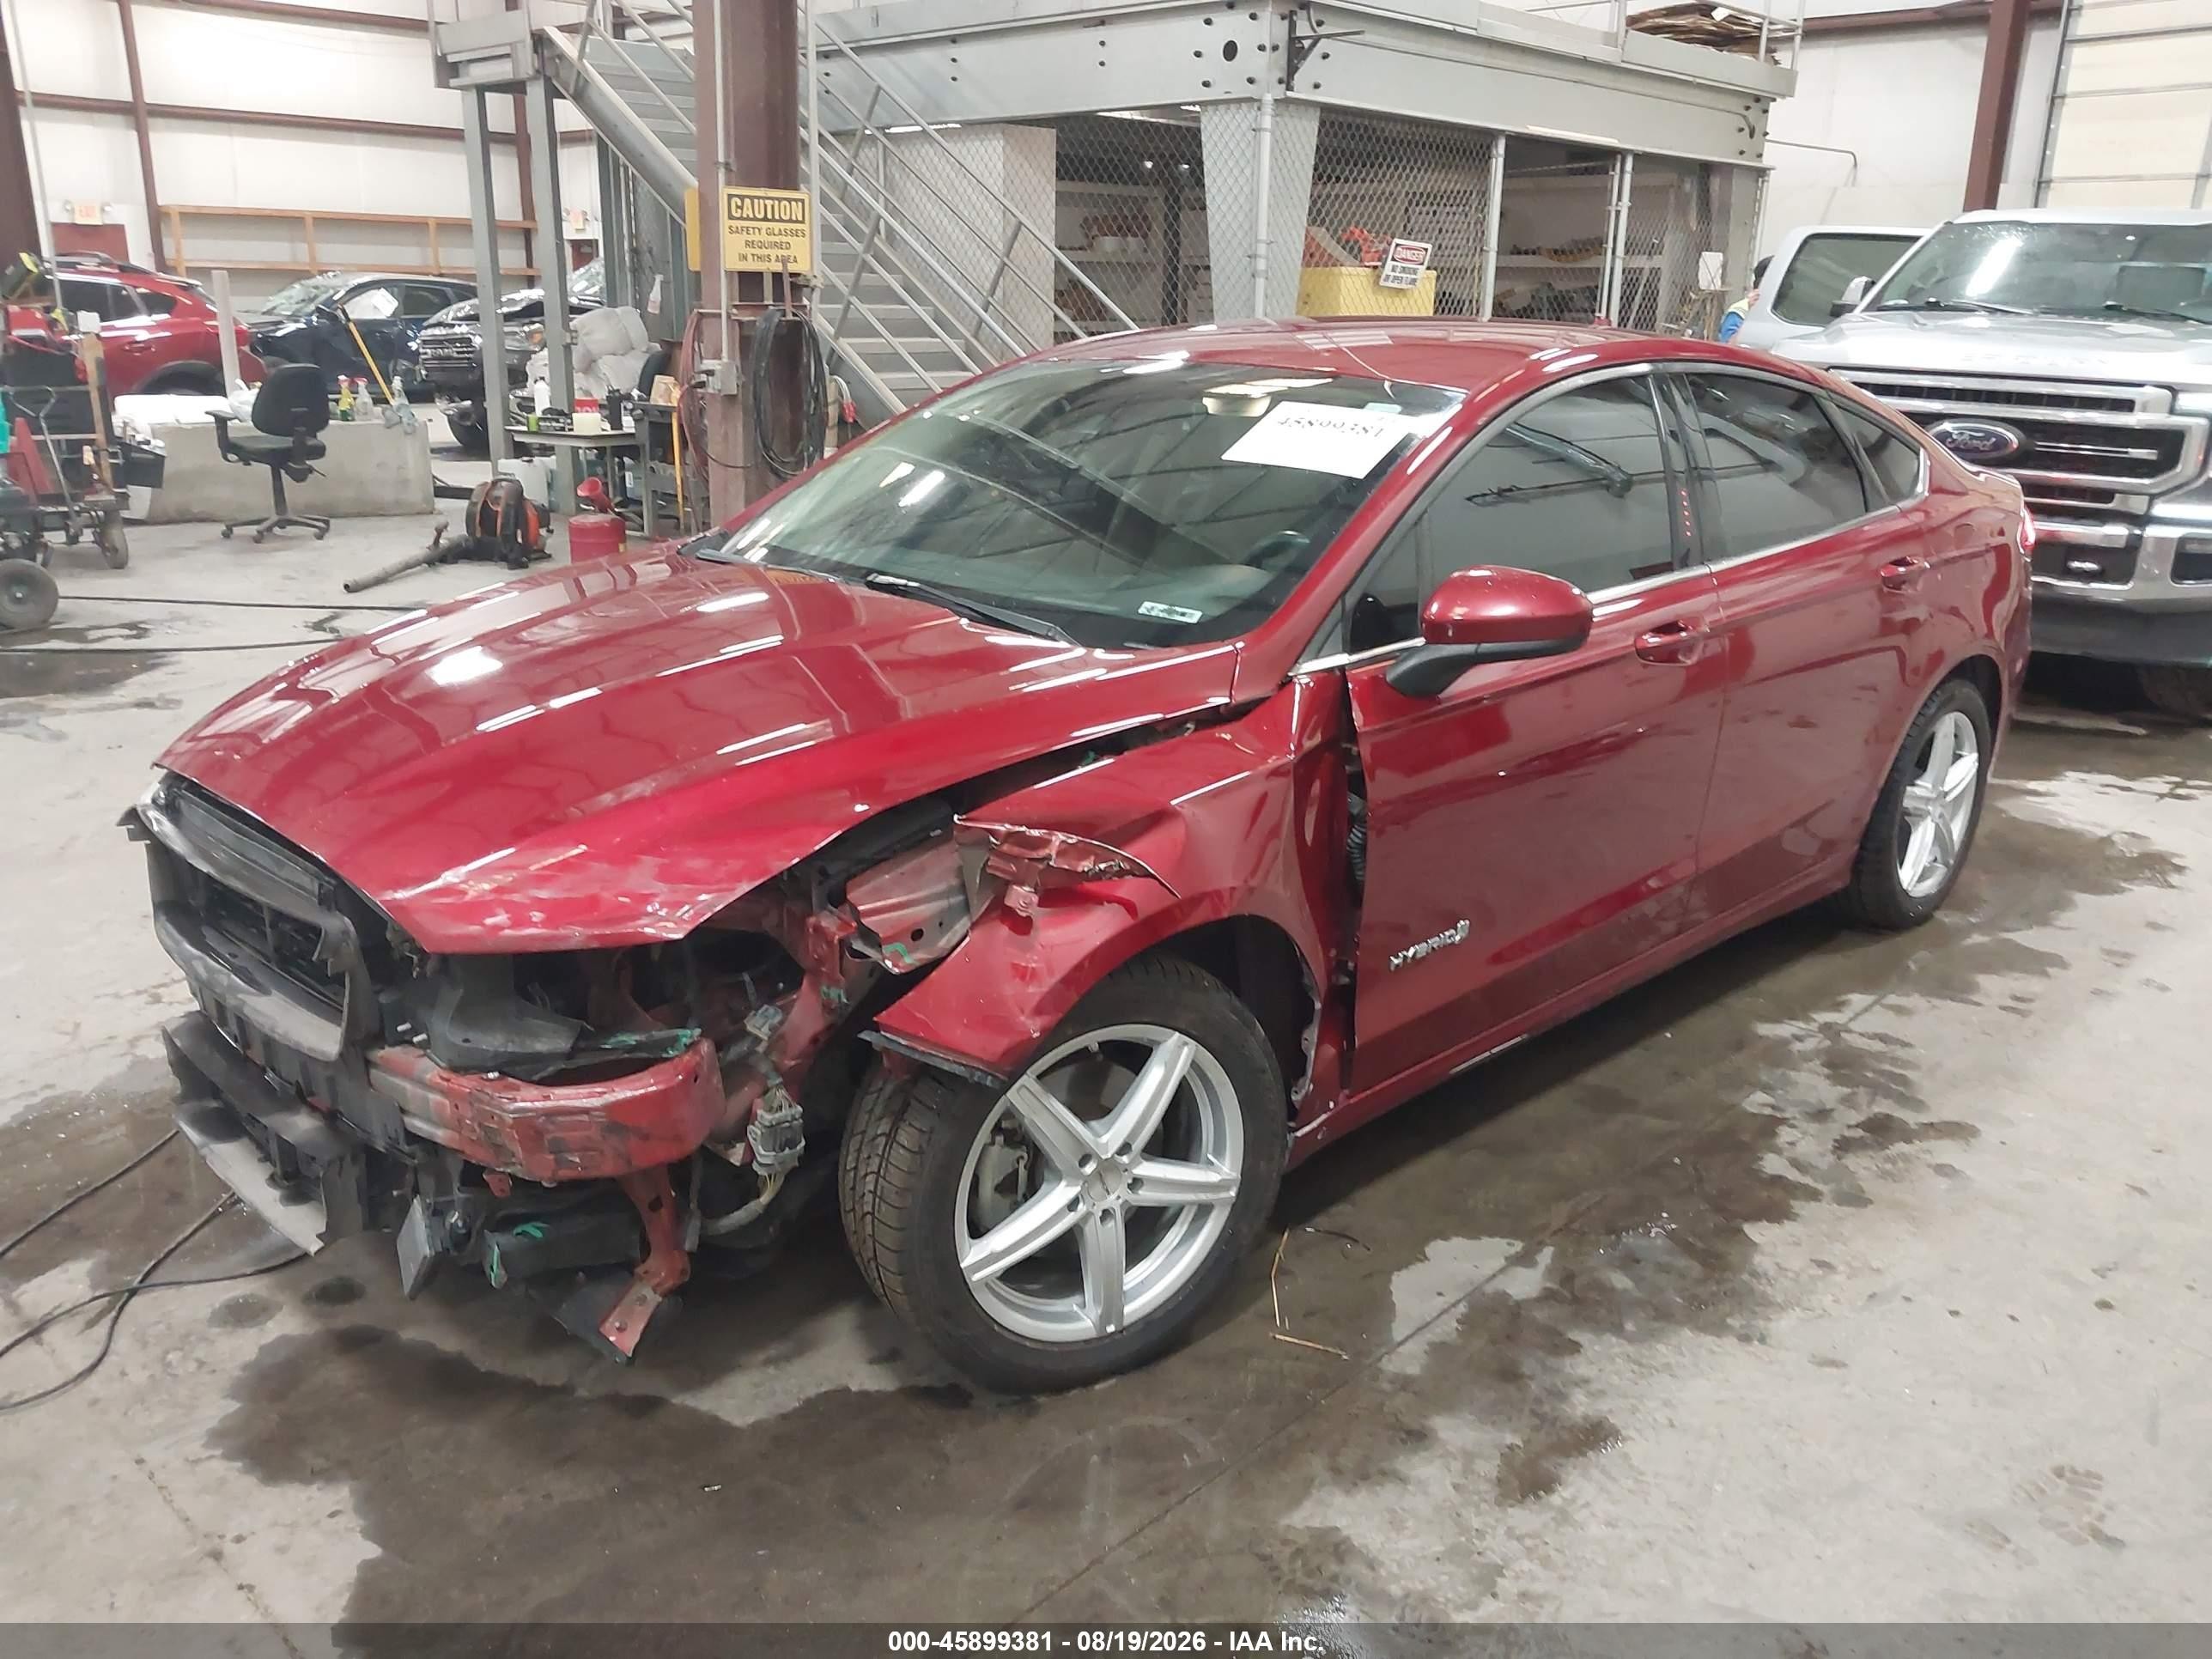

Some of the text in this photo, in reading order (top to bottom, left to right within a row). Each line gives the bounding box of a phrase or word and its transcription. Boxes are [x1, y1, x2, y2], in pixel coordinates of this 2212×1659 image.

[731, 198, 802, 221] CAUTION
[728, 225, 806, 238] SAFETY GLASSES
[744, 240, 792, 250] REQUIRED
[738, 252, 748, 262] IN
[750, 253, 772, 263] THIS
[1395, 247, 1424, 261] DANGER
[1945, 428, 1996, 451] Ford
[1389, 928, 1457, 972] HYBRID
